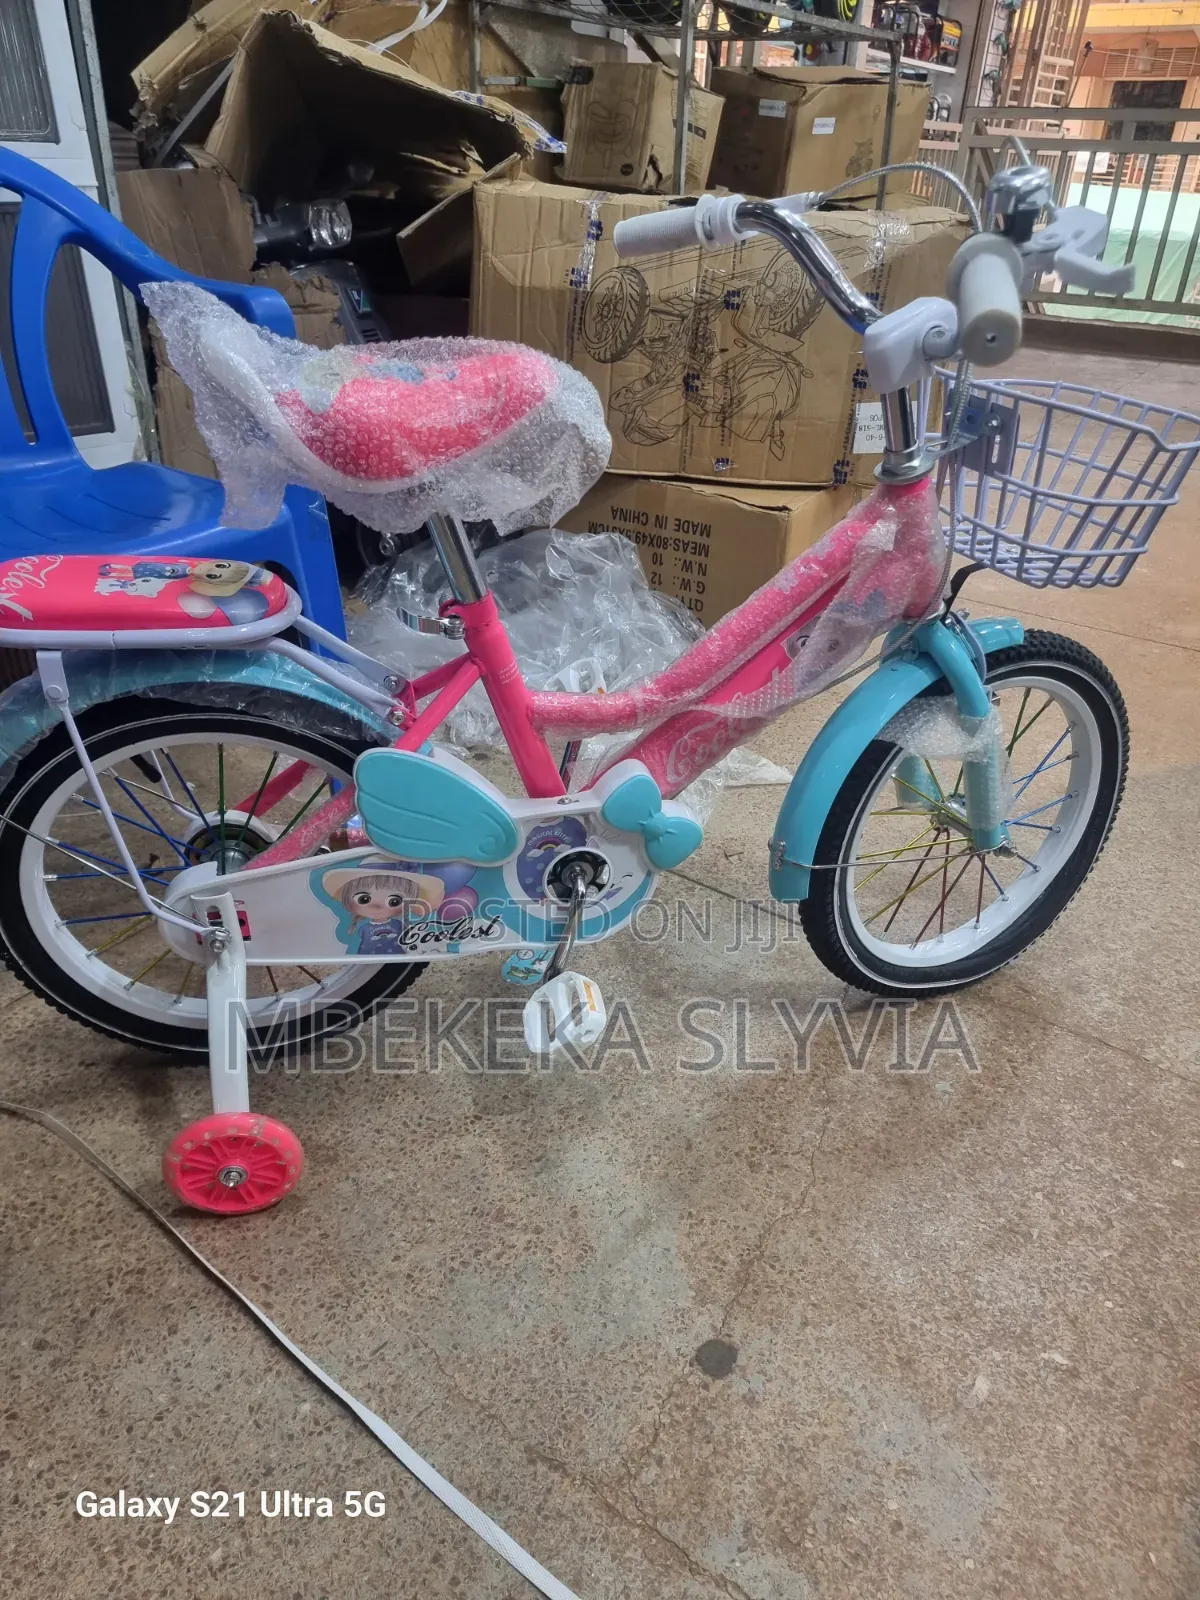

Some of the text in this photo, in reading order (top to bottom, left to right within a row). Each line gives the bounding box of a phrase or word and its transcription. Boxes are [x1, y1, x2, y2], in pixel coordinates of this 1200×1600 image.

[611, 506, 712, 538] MADE IN CHINA
[651, 552, 664, 566] 10
[650, 571, 663, 585] 12
[398, 914, 500, 946] Coolest
